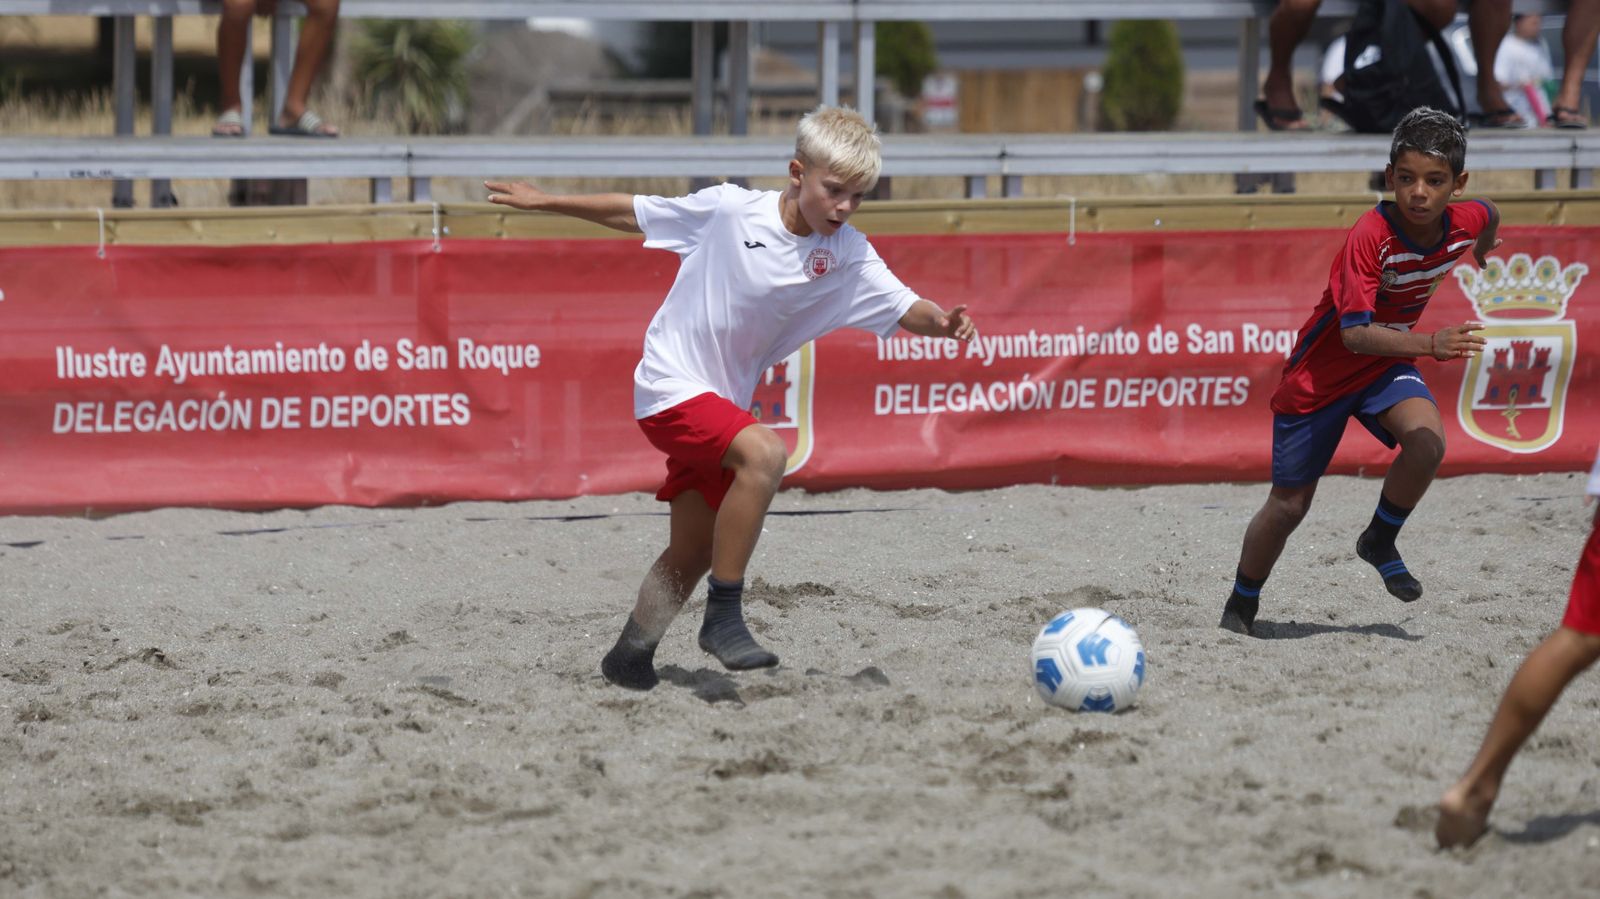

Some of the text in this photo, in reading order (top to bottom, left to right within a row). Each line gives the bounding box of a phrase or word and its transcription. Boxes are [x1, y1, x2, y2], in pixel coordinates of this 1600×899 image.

[56, 337, 541, 384] Ilustre Ayuntamiento de San Roque
[876, 322, 1298, 367] Ilustre Ayuntamiento de San Roq
[53, 391, 471, 434] DELEGACIÓN DE DEPORTES
[874, 374, 1250, 416] DELEGACIÓN DE DEPORTES
